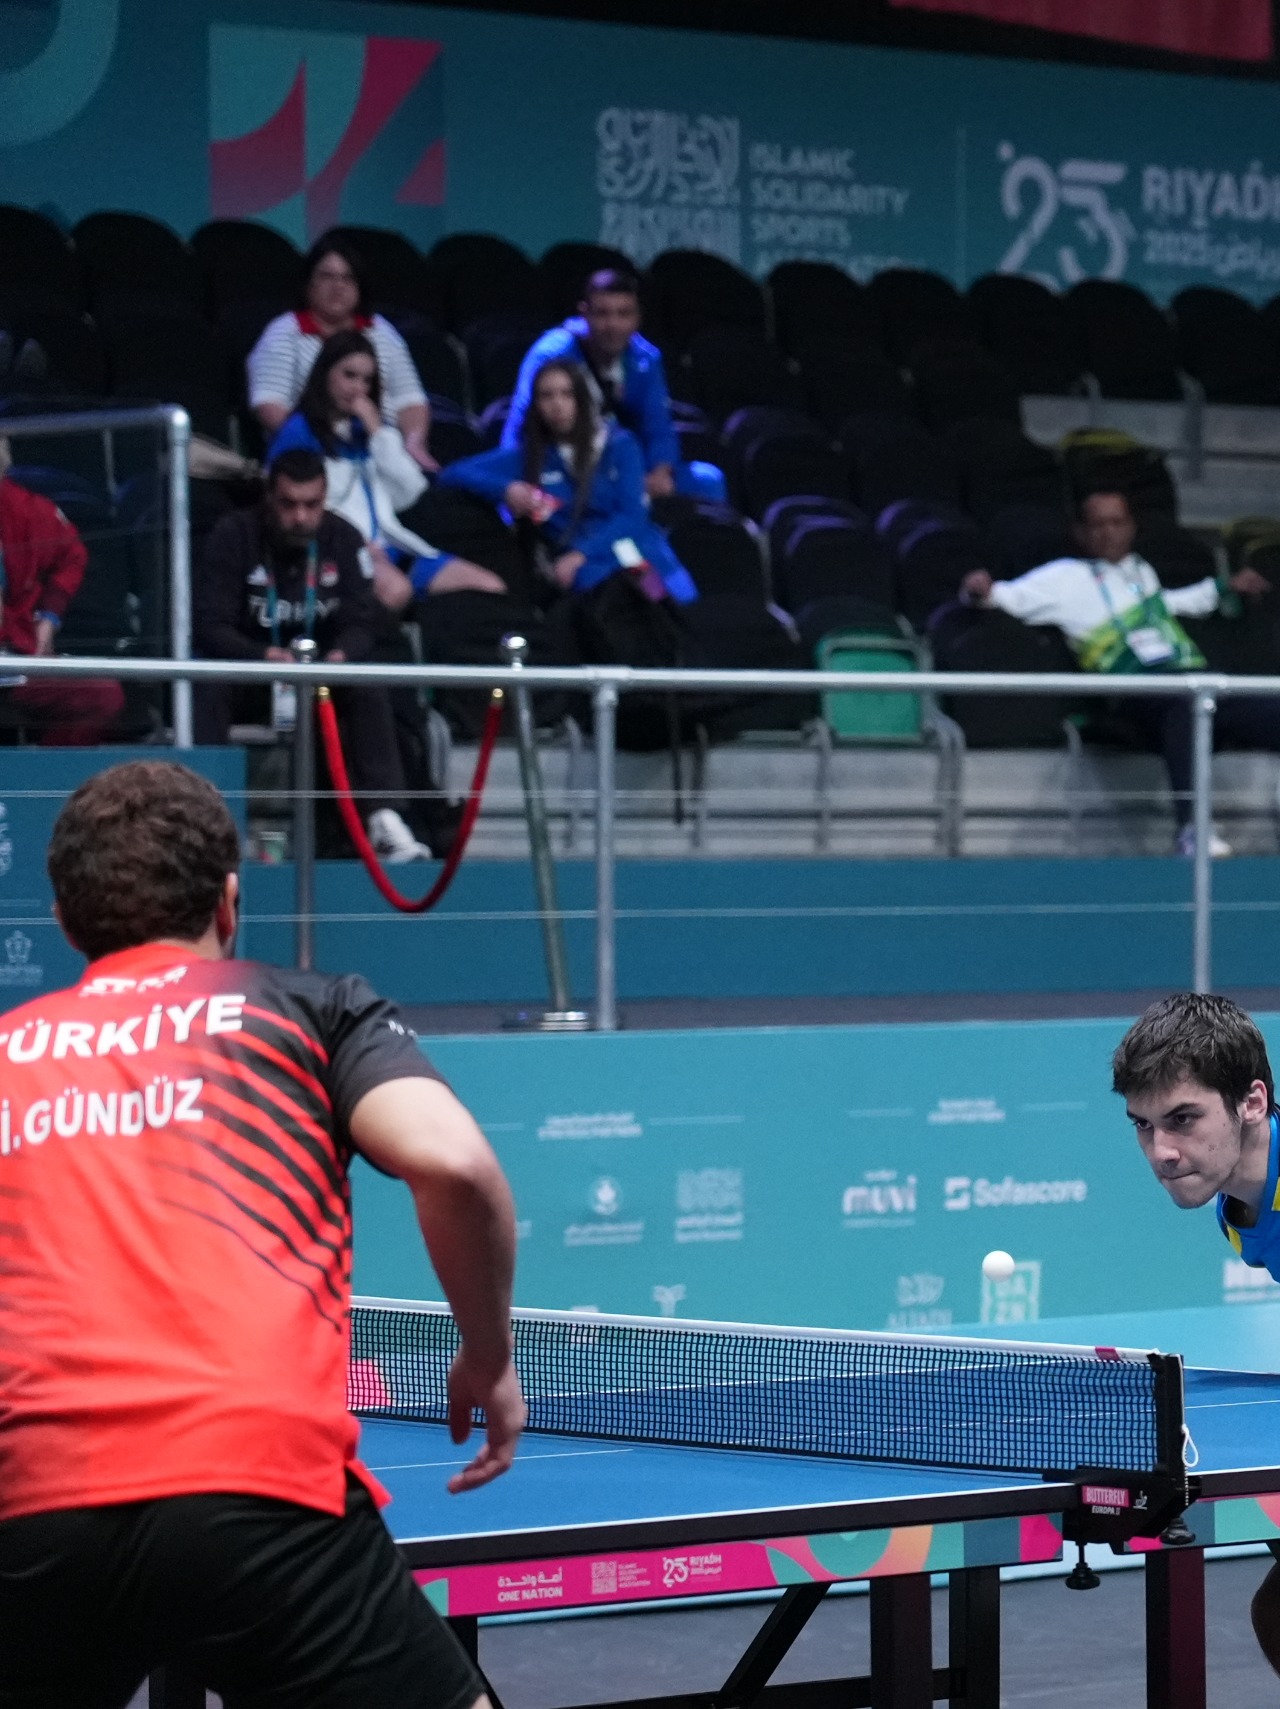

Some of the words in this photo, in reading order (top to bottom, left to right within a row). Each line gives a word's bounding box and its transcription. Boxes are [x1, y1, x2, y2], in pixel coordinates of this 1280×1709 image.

[749, 141, 856, 179] ISLAMIC
[749, 177, 910, 217] SOLIDARITY
[750, 213, 851, 249] SPORTS
[973, 1176, 1087, 1208] Sofascore
[1086, 1487, 1125, 1505] BUTTERFLY
[1092, 1506, 1115, 1515] EUROPA
[663, 1557, 689, 1588] 25
[498, 1591, 520, 1602] ONE
[521, 1586, 563, 1600] NATION
